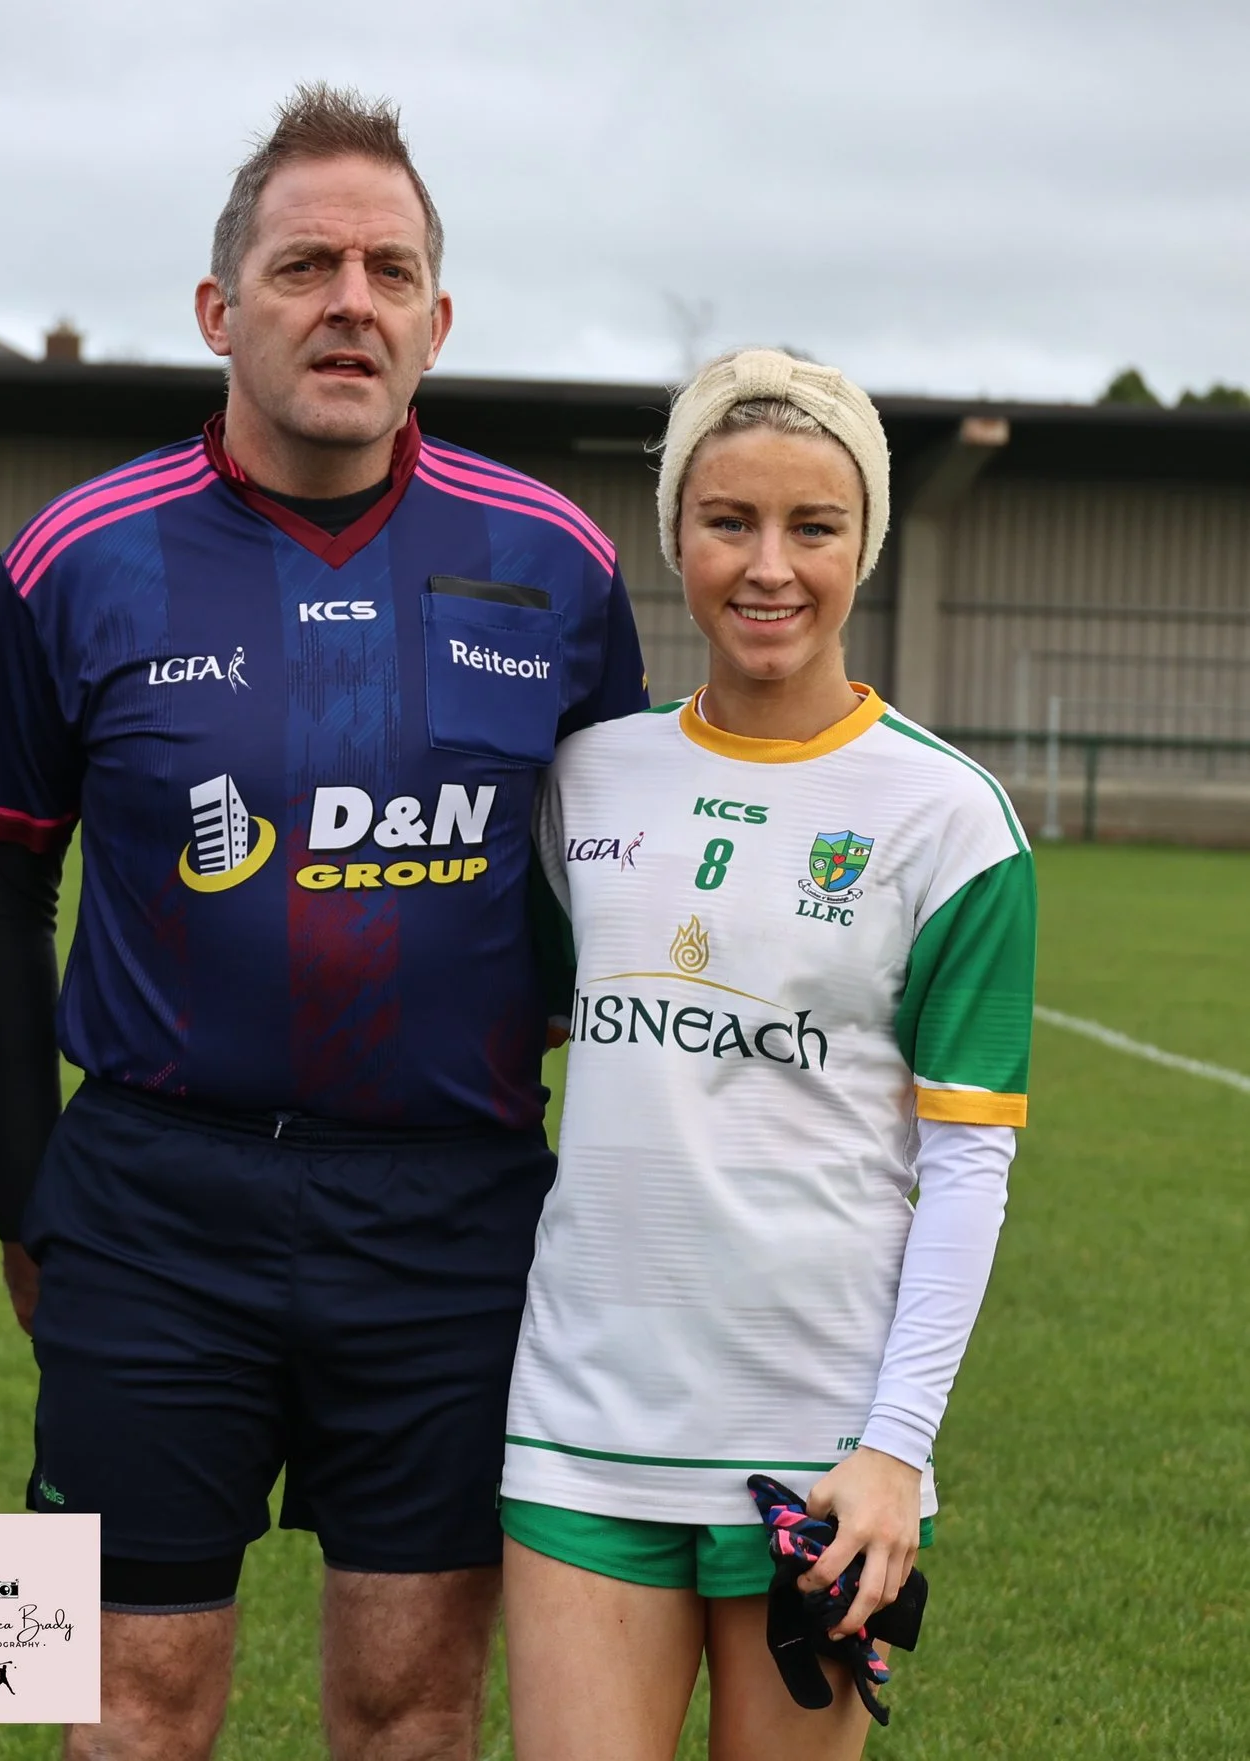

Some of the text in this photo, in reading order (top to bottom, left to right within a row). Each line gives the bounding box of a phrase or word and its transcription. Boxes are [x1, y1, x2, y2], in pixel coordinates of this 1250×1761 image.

[298, 600, 377, 622] KCS
[148, 654, 226, 686] LGFA
[449, 639, 550, 680] Réiteoir
[308, 784, 497, 852] D&N
[693, 797, 770, 825] KCS
[567, 838, 621, 862] LGFA
[694, 837, 735, 891] 8
[296, 857, 489, 890] GROUP
[795, 899, 854, 927] LLFC
